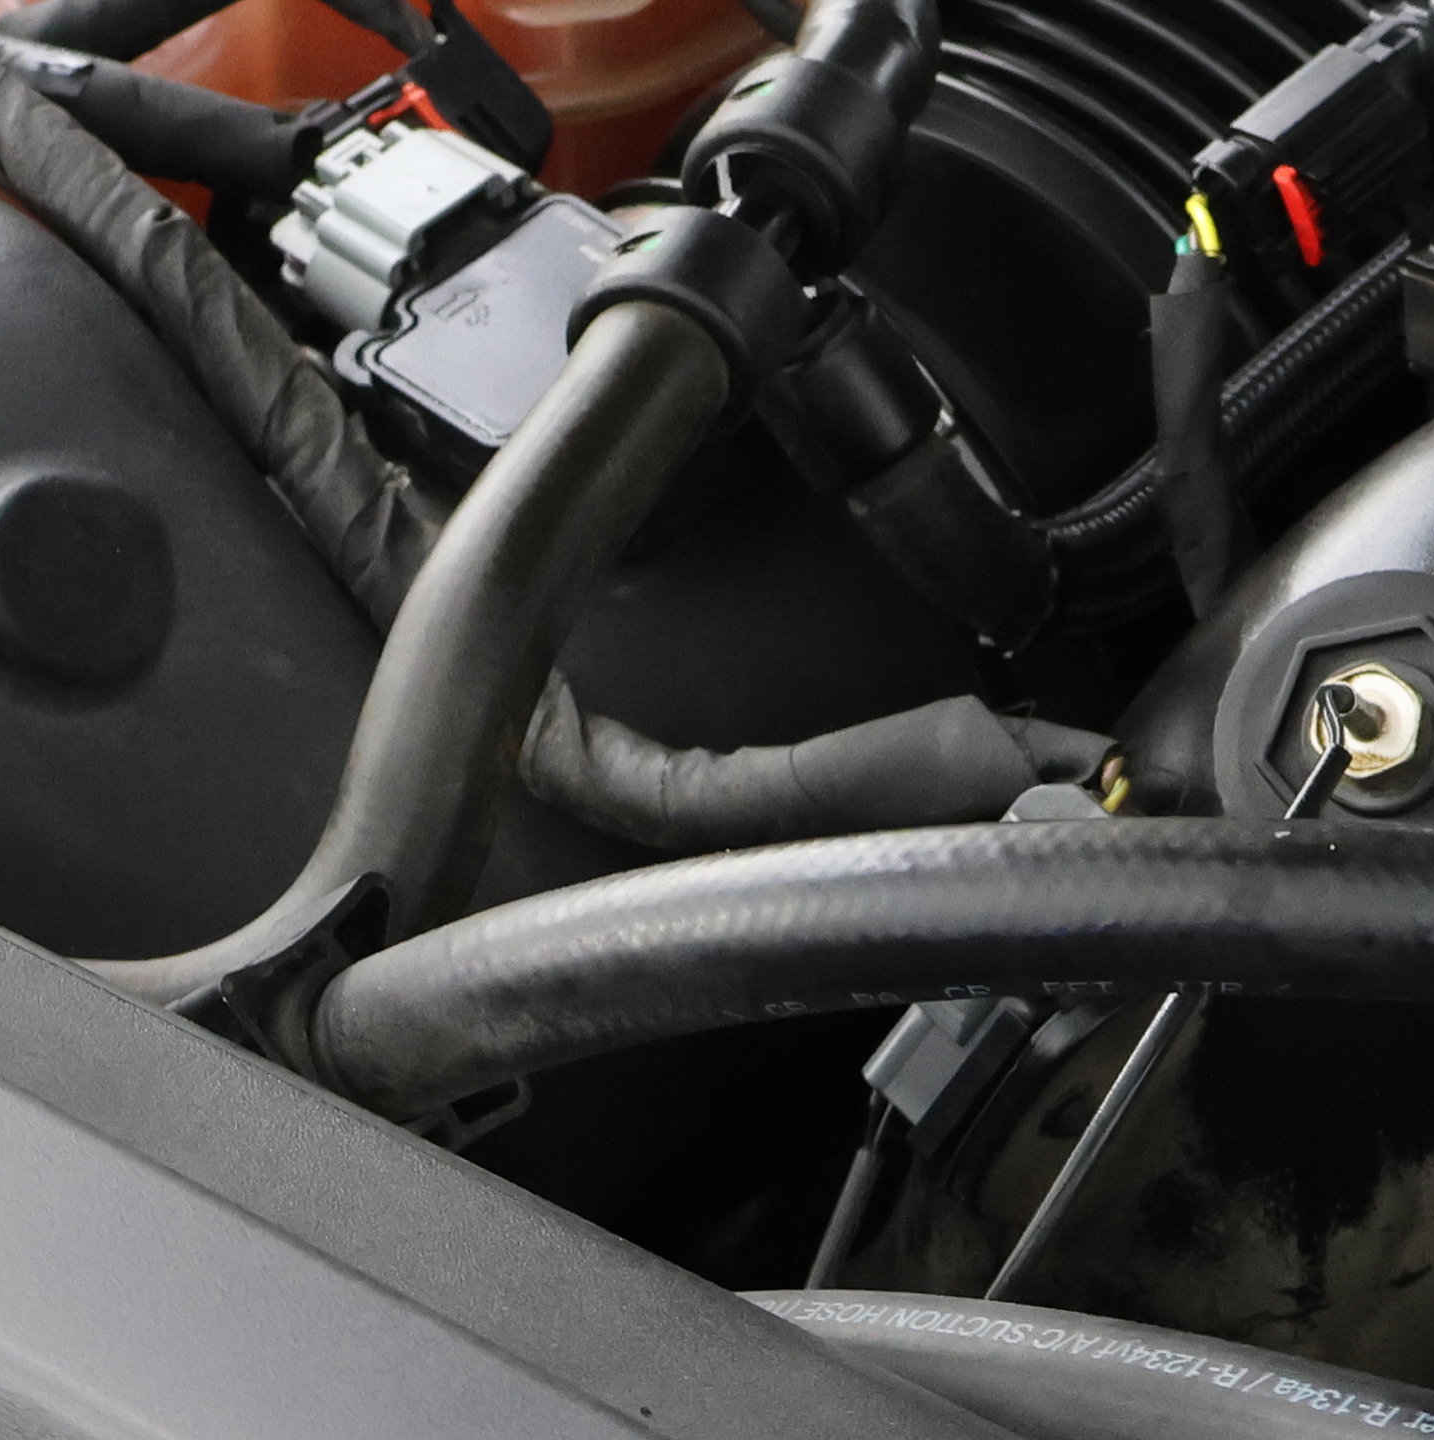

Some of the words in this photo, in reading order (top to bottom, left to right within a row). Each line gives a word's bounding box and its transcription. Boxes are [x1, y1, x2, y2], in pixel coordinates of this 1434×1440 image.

[795, 1300, 890, 1326] HOSE
[884, 1308, 1034, 1344] SUCTION
[1032, 1327, 1102, 1356] A/C
[1091, 1338, 1251, 1389] R-1234yf
[1274, 1375, 1402, 1428] R-134a
